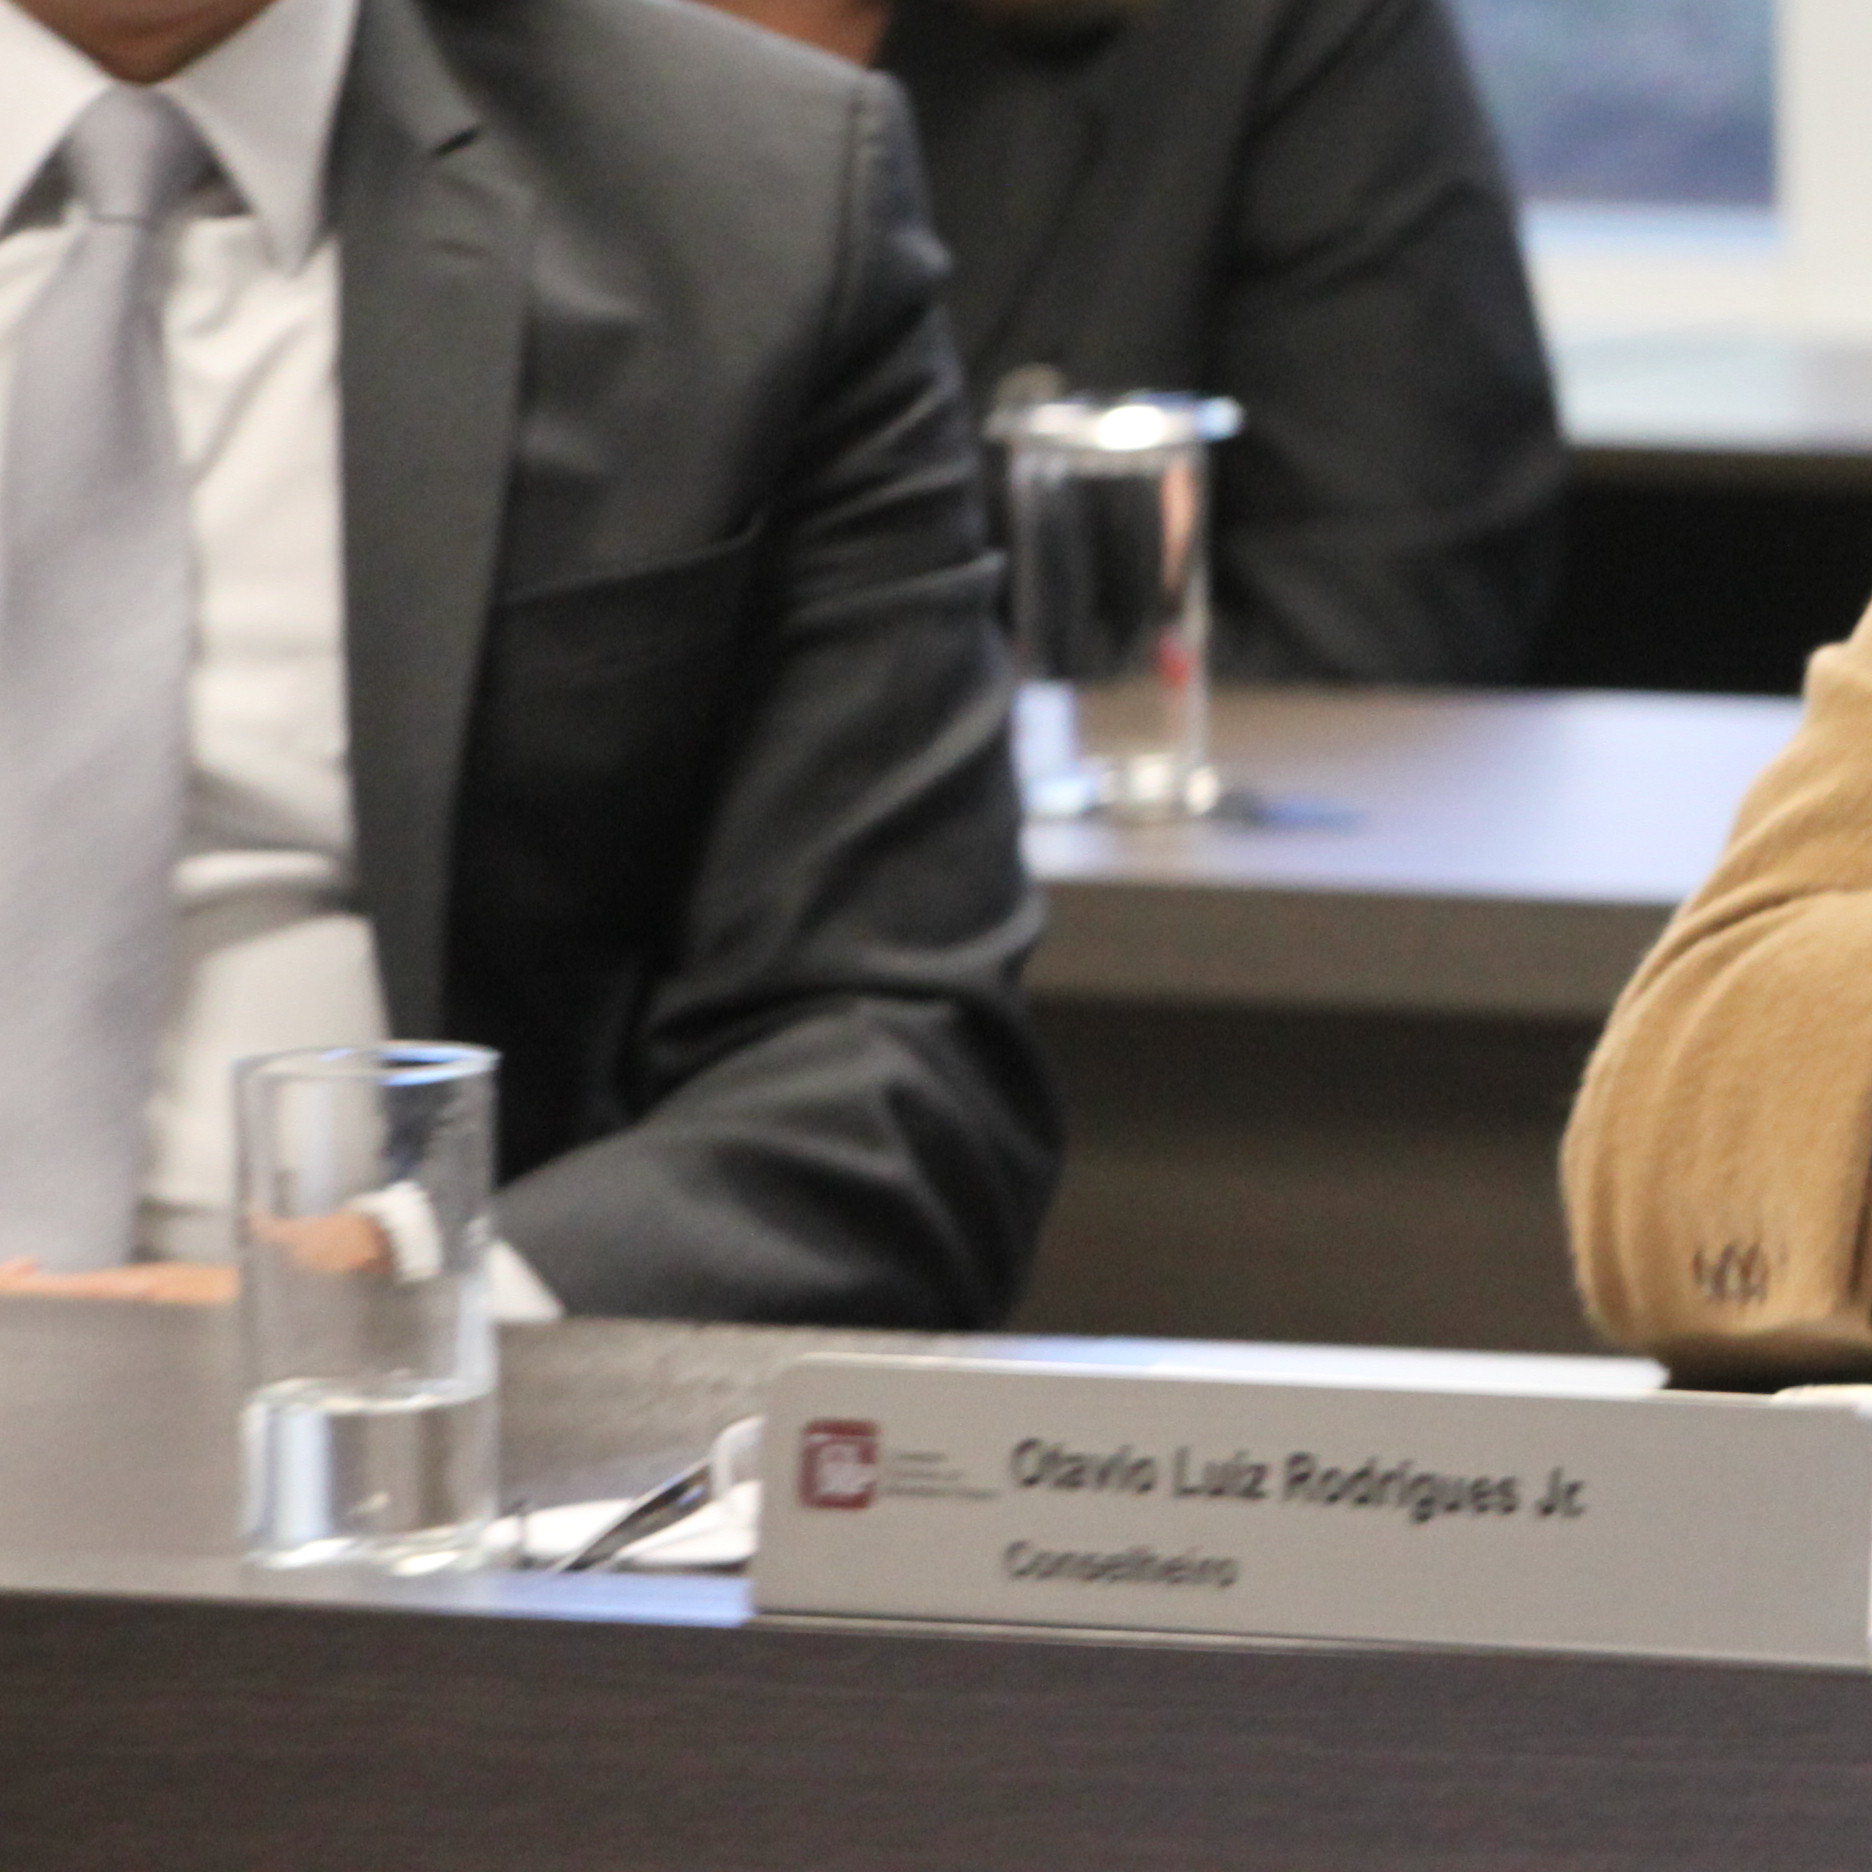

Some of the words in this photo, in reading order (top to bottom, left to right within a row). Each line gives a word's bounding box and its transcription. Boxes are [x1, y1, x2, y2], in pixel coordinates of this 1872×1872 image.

[1010, 1438, 1157, 1494] Otavio
[1173, 1446, 1268, 1500] Luiz
[1283, 1451, 1520, 1526] Rodrigues
